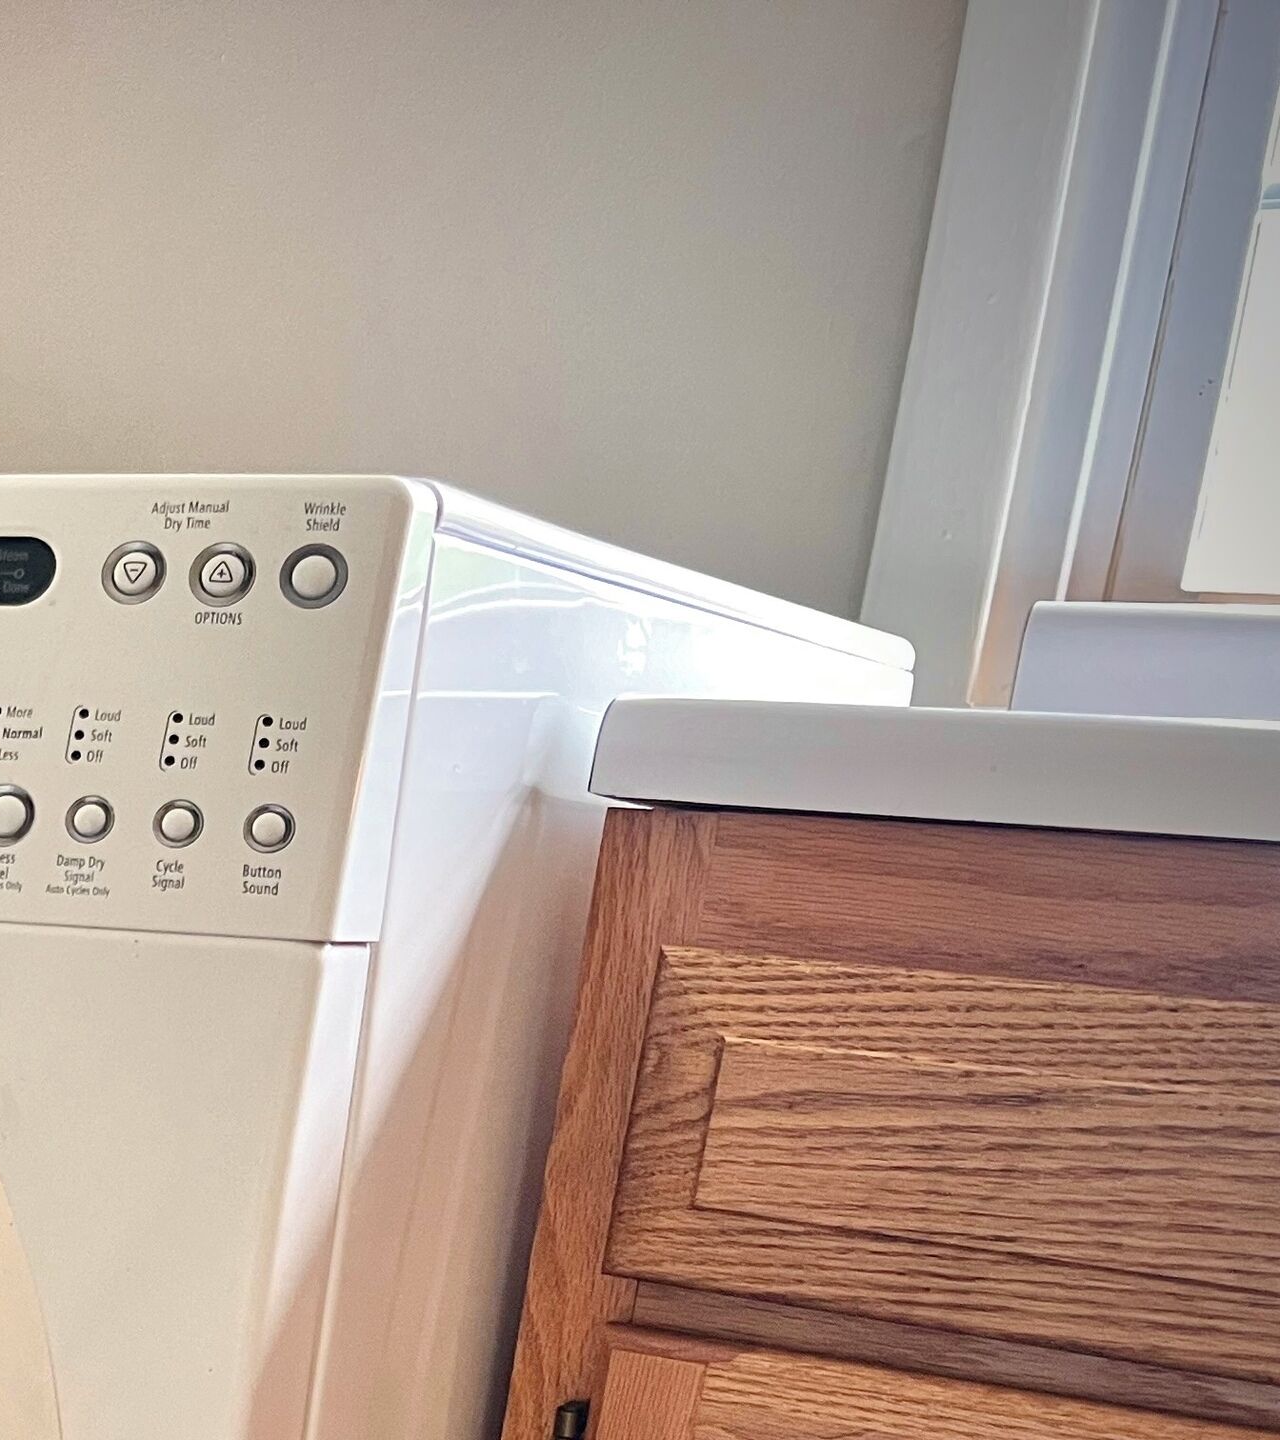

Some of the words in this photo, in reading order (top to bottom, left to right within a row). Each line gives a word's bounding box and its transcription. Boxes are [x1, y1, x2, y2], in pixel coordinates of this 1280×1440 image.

[151, 501, 186, 517] Adjust
[188, 500, 229, 513] Manual
[304, 502, 346, 516] Wrinkle
[164, 517, 183, 532] Dry
[186, 517, 210, 529] Time
[305, 519, 340, 532] Shield
[3, 581, 30, 594] Done
[194, 612, 242, 625] OPTIONS
[6, 706, 33, 718] More
[94, 709, 122, 722] Loud
[188, 713, 215, 726] Loud
[279, 717, 308, 731] Loud
[2, 727, 43, 739] Normal
[91, 729, 113, 742] Soft
[185, 735, 207, 748] Soft
[276, 738, 299, 753] Soft
[86, 750, 104, 763] Off
[180, 756, 198, 770] Off
[271, 760, 290, 774] Off
[56, 854, 85, 870] Damp
[88, 856, 105, 872] Dry
[156, 859, 185, 875] Cycle
[64, 870, 95, 885] Signal
[242, 864, 281, 879] Button
[5, 881, 22, 893] Only
[152, 875, 185, 892] Signal
[242, 880, 279, 896] Sound
[45, 884, 64, 894] Auto
[66, 885, 90, 896] Cycles
[92, 886, 110, 899] Only
